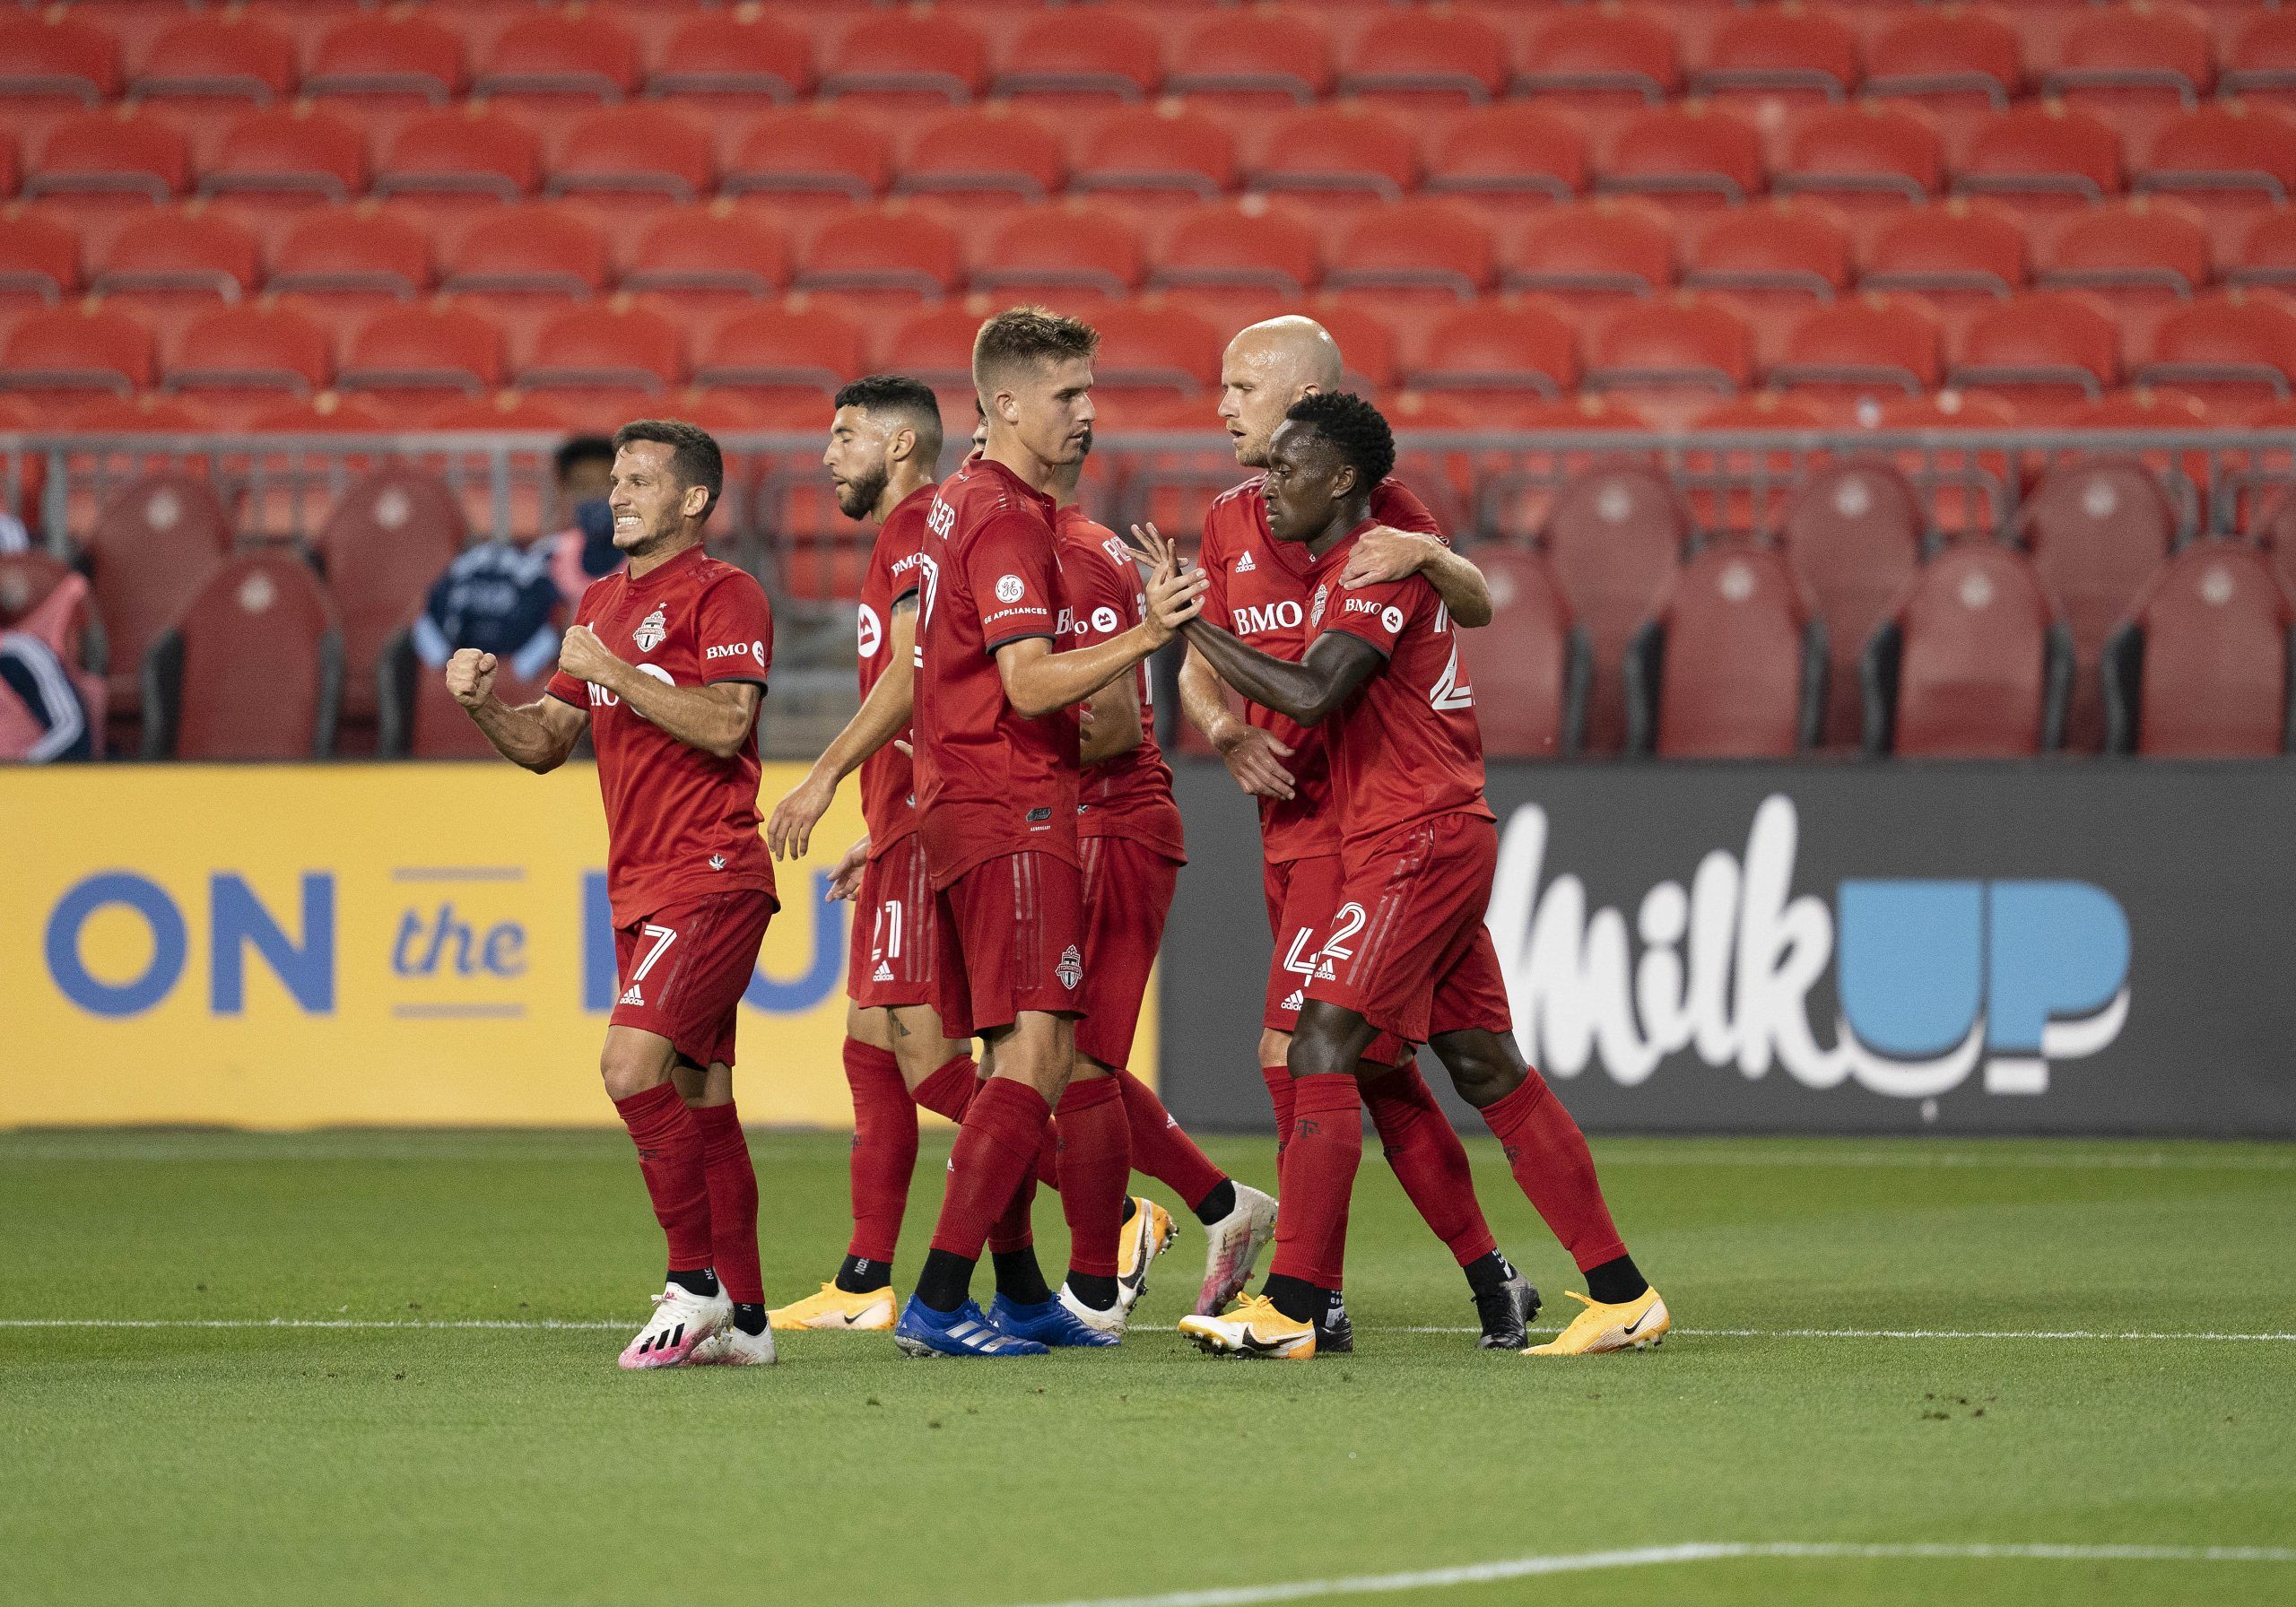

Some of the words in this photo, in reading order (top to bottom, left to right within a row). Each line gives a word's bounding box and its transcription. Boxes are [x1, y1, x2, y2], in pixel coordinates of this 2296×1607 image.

[927, 492, 955, 541] SER
[1235, 562, 1256, 573] adidas
[984, 616, 992, 625] GE
[993, 606, 1048, 621] APPLIANCES
[1344, 598, 1382, 615] BMO
[1055, 604, 1089, 637] BO
[1233, 600, 1303, 636] BMO
[706, 642, 748, 660] BMO
[587, 681, 621, 707] MO
[45, 869, 337, 1018] ON
[391, 904, 527, 977] the
[583, 870, 848, 1015] U
[632, 924, 678, 981] 7
[1283, 926, 1323, 987] 4
[873, 973, 895, 982] adidas
[619, 995, 645, 1006] adidas
[1281, 1001, 1302, 1012] adid
